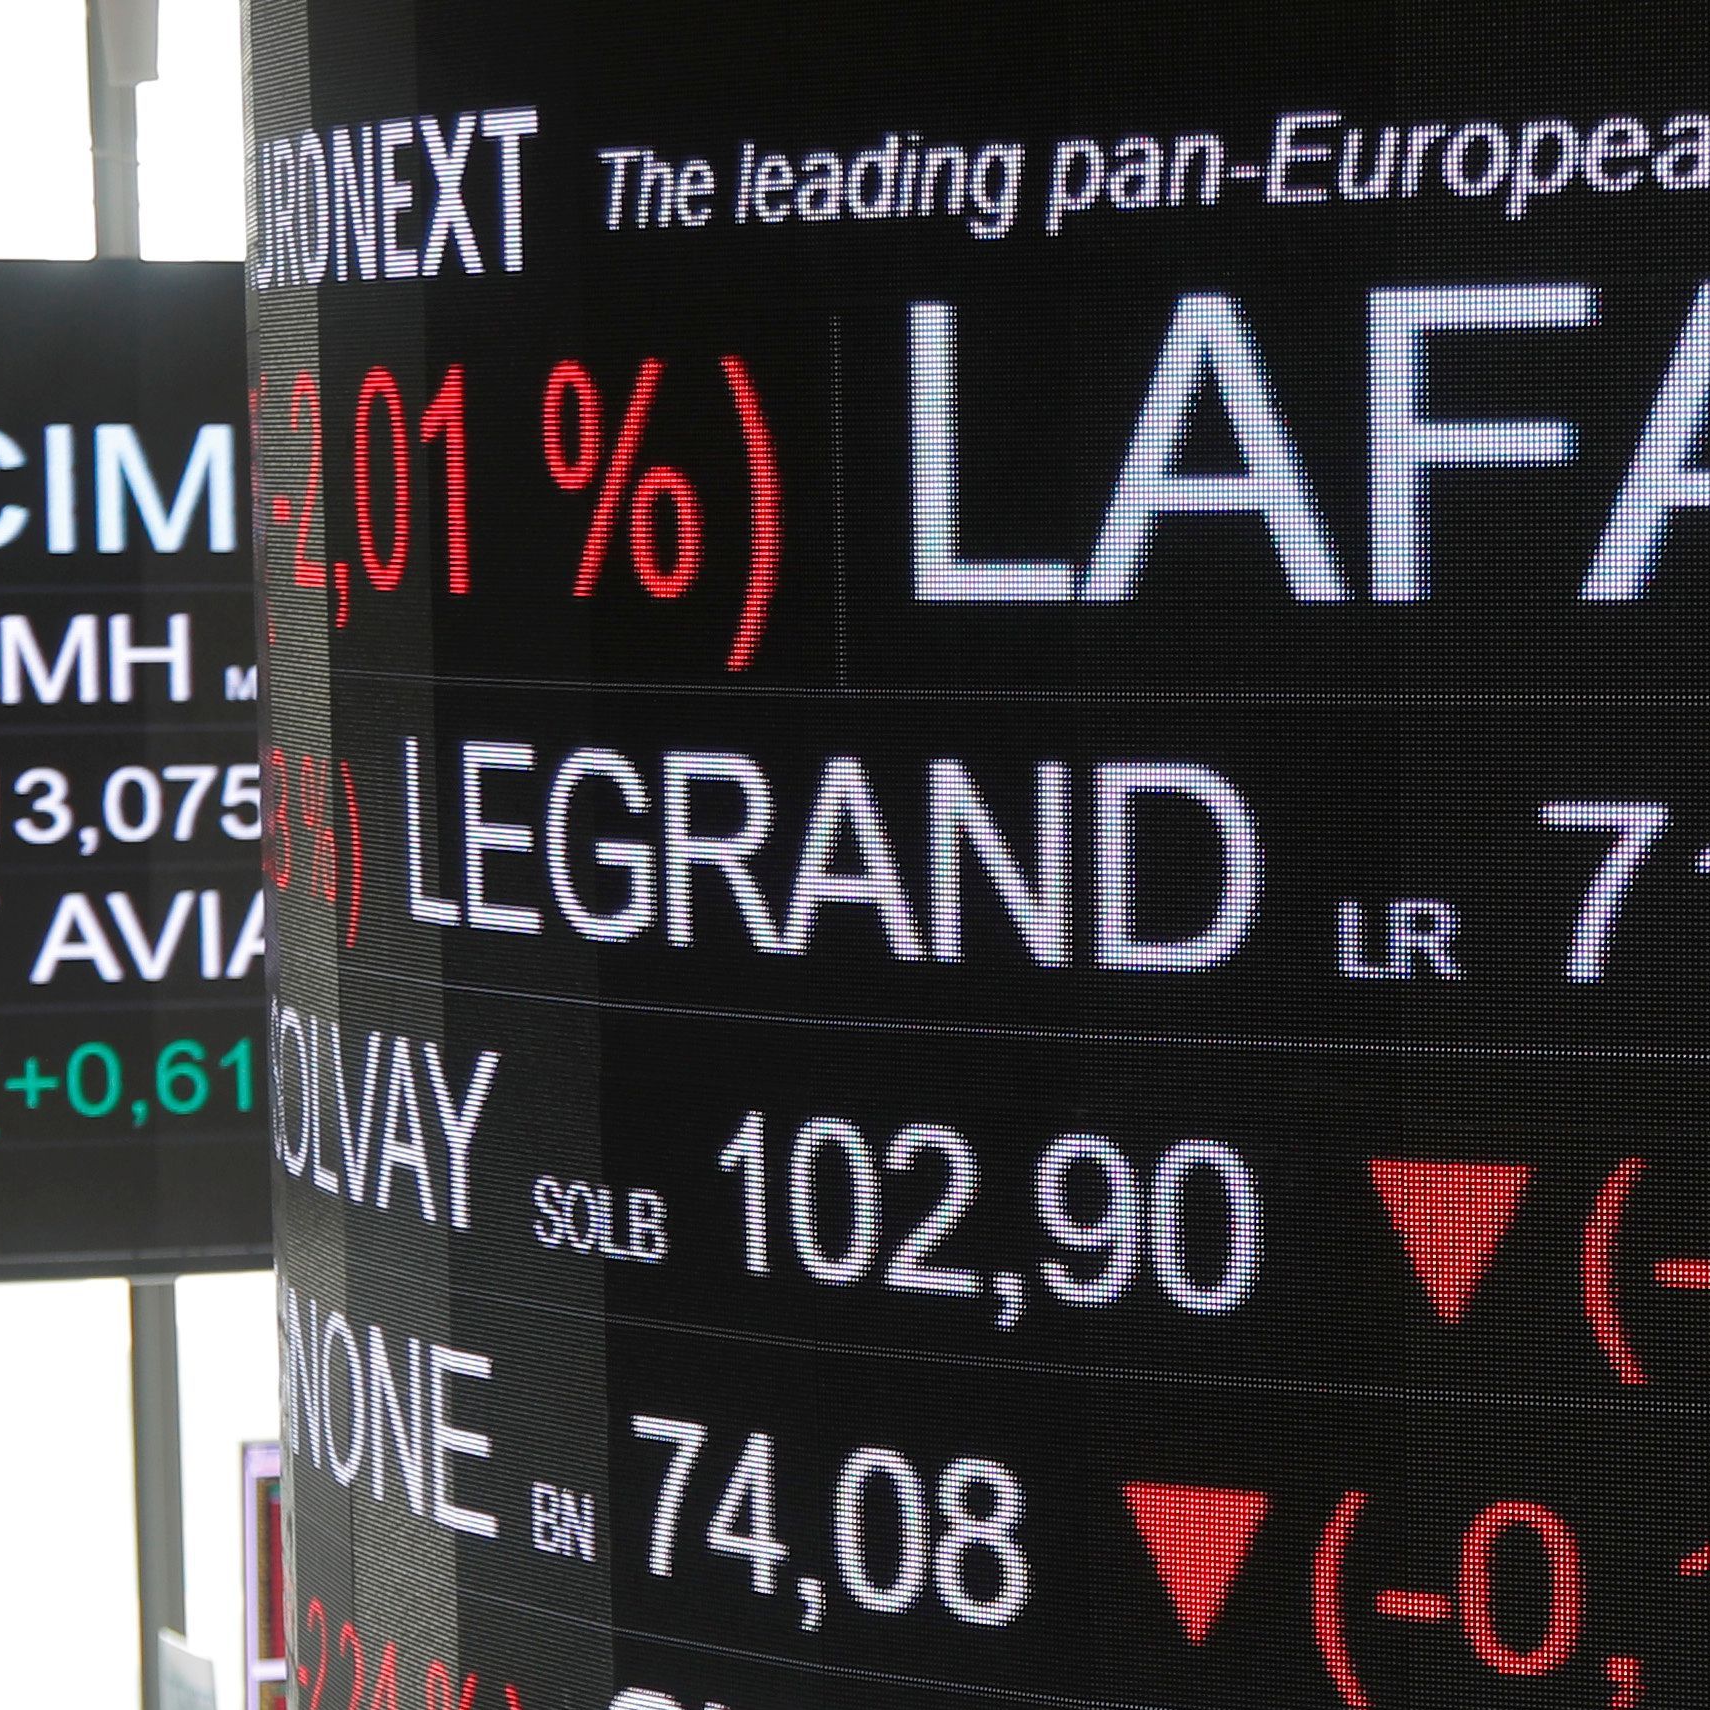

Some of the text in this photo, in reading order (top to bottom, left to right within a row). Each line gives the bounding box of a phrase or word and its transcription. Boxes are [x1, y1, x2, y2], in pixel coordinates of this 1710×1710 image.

[600, 146, 717, 229] The
[734, 133, 1025, 240] leading
[541, 355, 781, 670] %)
[403, 737, 1259, 971] LEGRAND
[1337, 898, 1460, 979] LR
[531, 1174, 668, 1263] SOLB
[719, 1111, 1259, 1327] 102,90
[531, 1480, 595, 1560] BN
[632, 1413, 1029, 1630] 74,08
